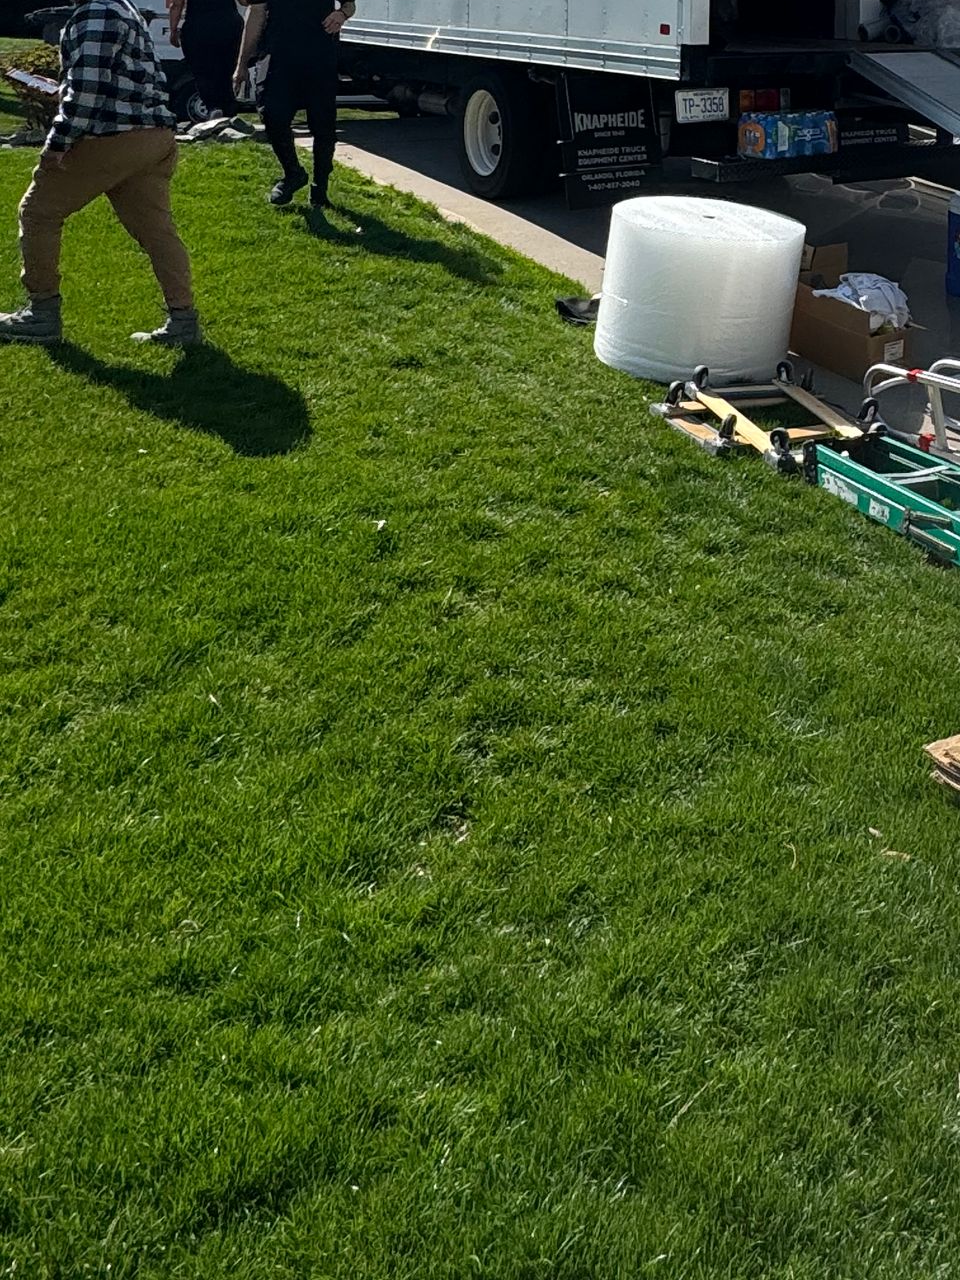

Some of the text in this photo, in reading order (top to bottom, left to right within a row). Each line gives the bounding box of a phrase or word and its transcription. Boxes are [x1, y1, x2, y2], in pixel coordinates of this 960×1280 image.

[574, 108, 646, 133] KNAPHEIDE
[621, 145, 647, 153] TRUCK
[619, 154, 648, 162] CENTER
[616, 169, 646, 178] FLORIDA
